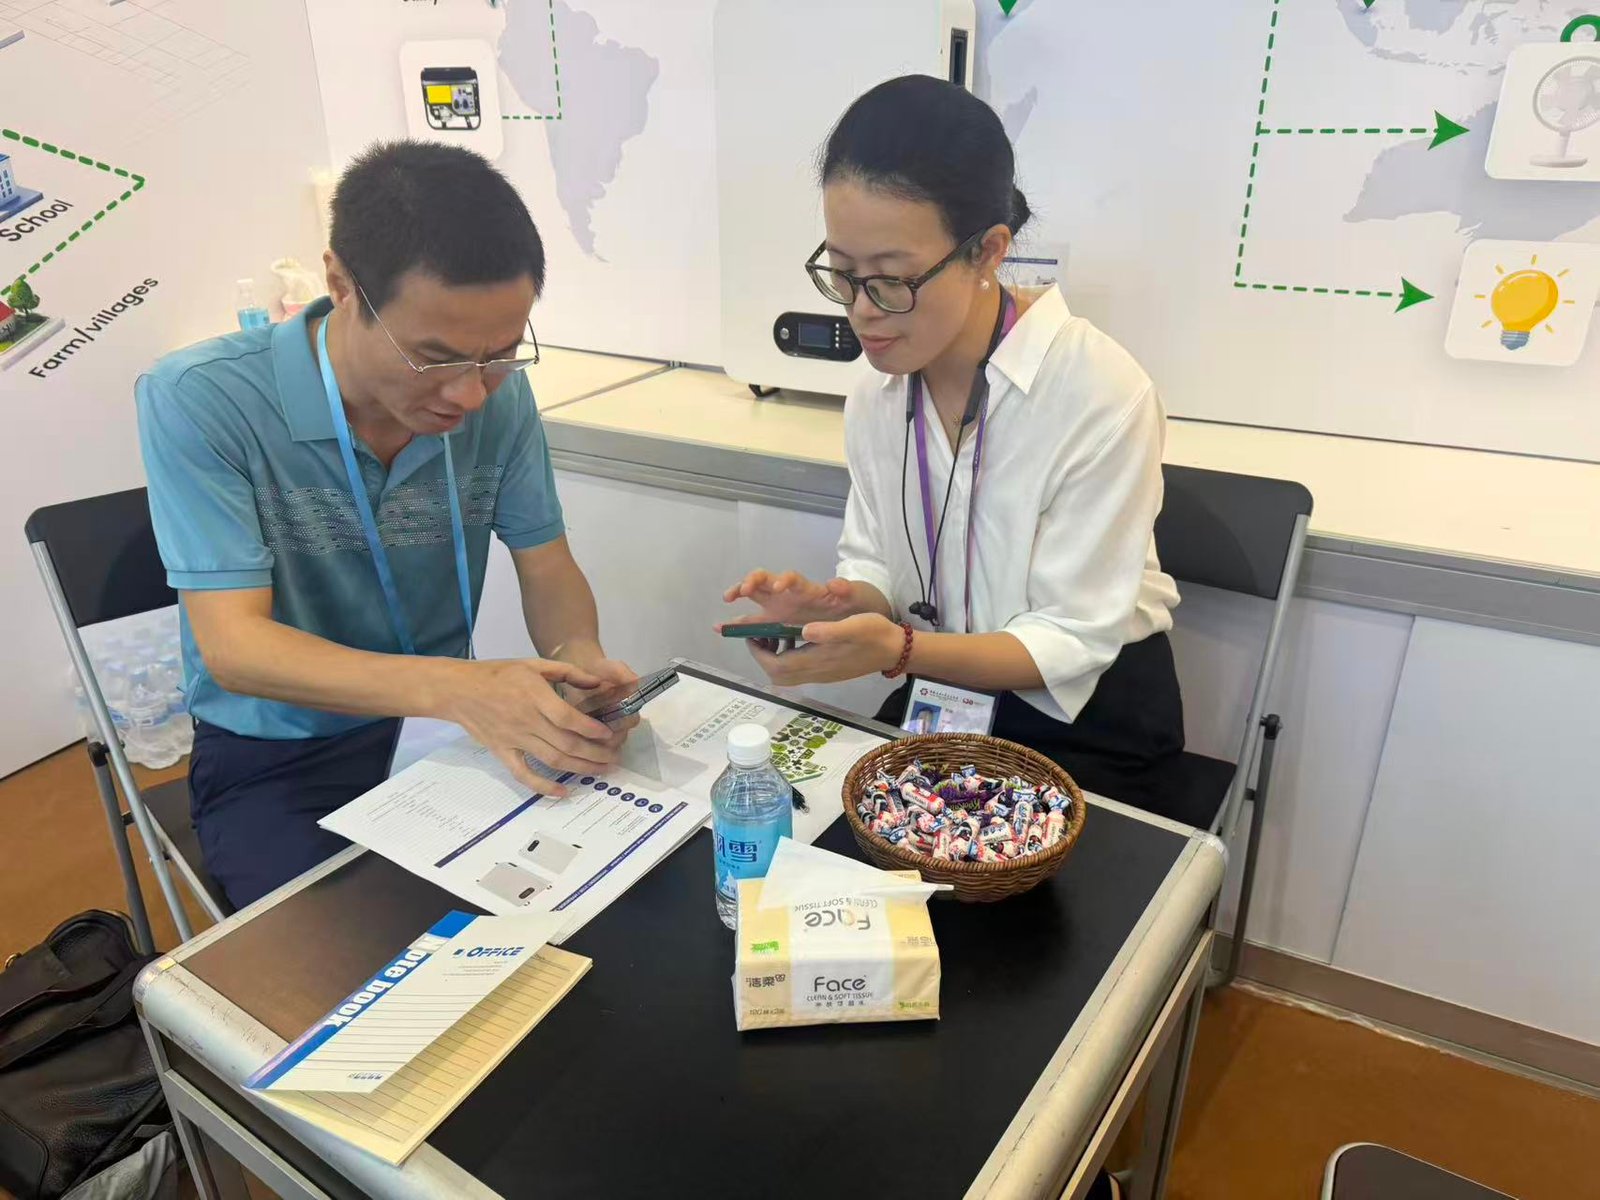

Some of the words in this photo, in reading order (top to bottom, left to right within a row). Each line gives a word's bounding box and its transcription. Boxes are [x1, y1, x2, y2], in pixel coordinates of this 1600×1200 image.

[0, 199, 74, 242] School
[28, 277, 159, 379] Farm/villages
[823, 897, 845, 908] SOFT
[804, 908, 871, 931] Face
[384, 932, 449, 979] Note
[466, 946, 525, 958] OFFICE
[814, 976, 866, 992] Face
[322, 979, 395, 1027] book
[806, 994, 828, 1002] CLEAN
[834, 993, 851, 1001] SOFT
